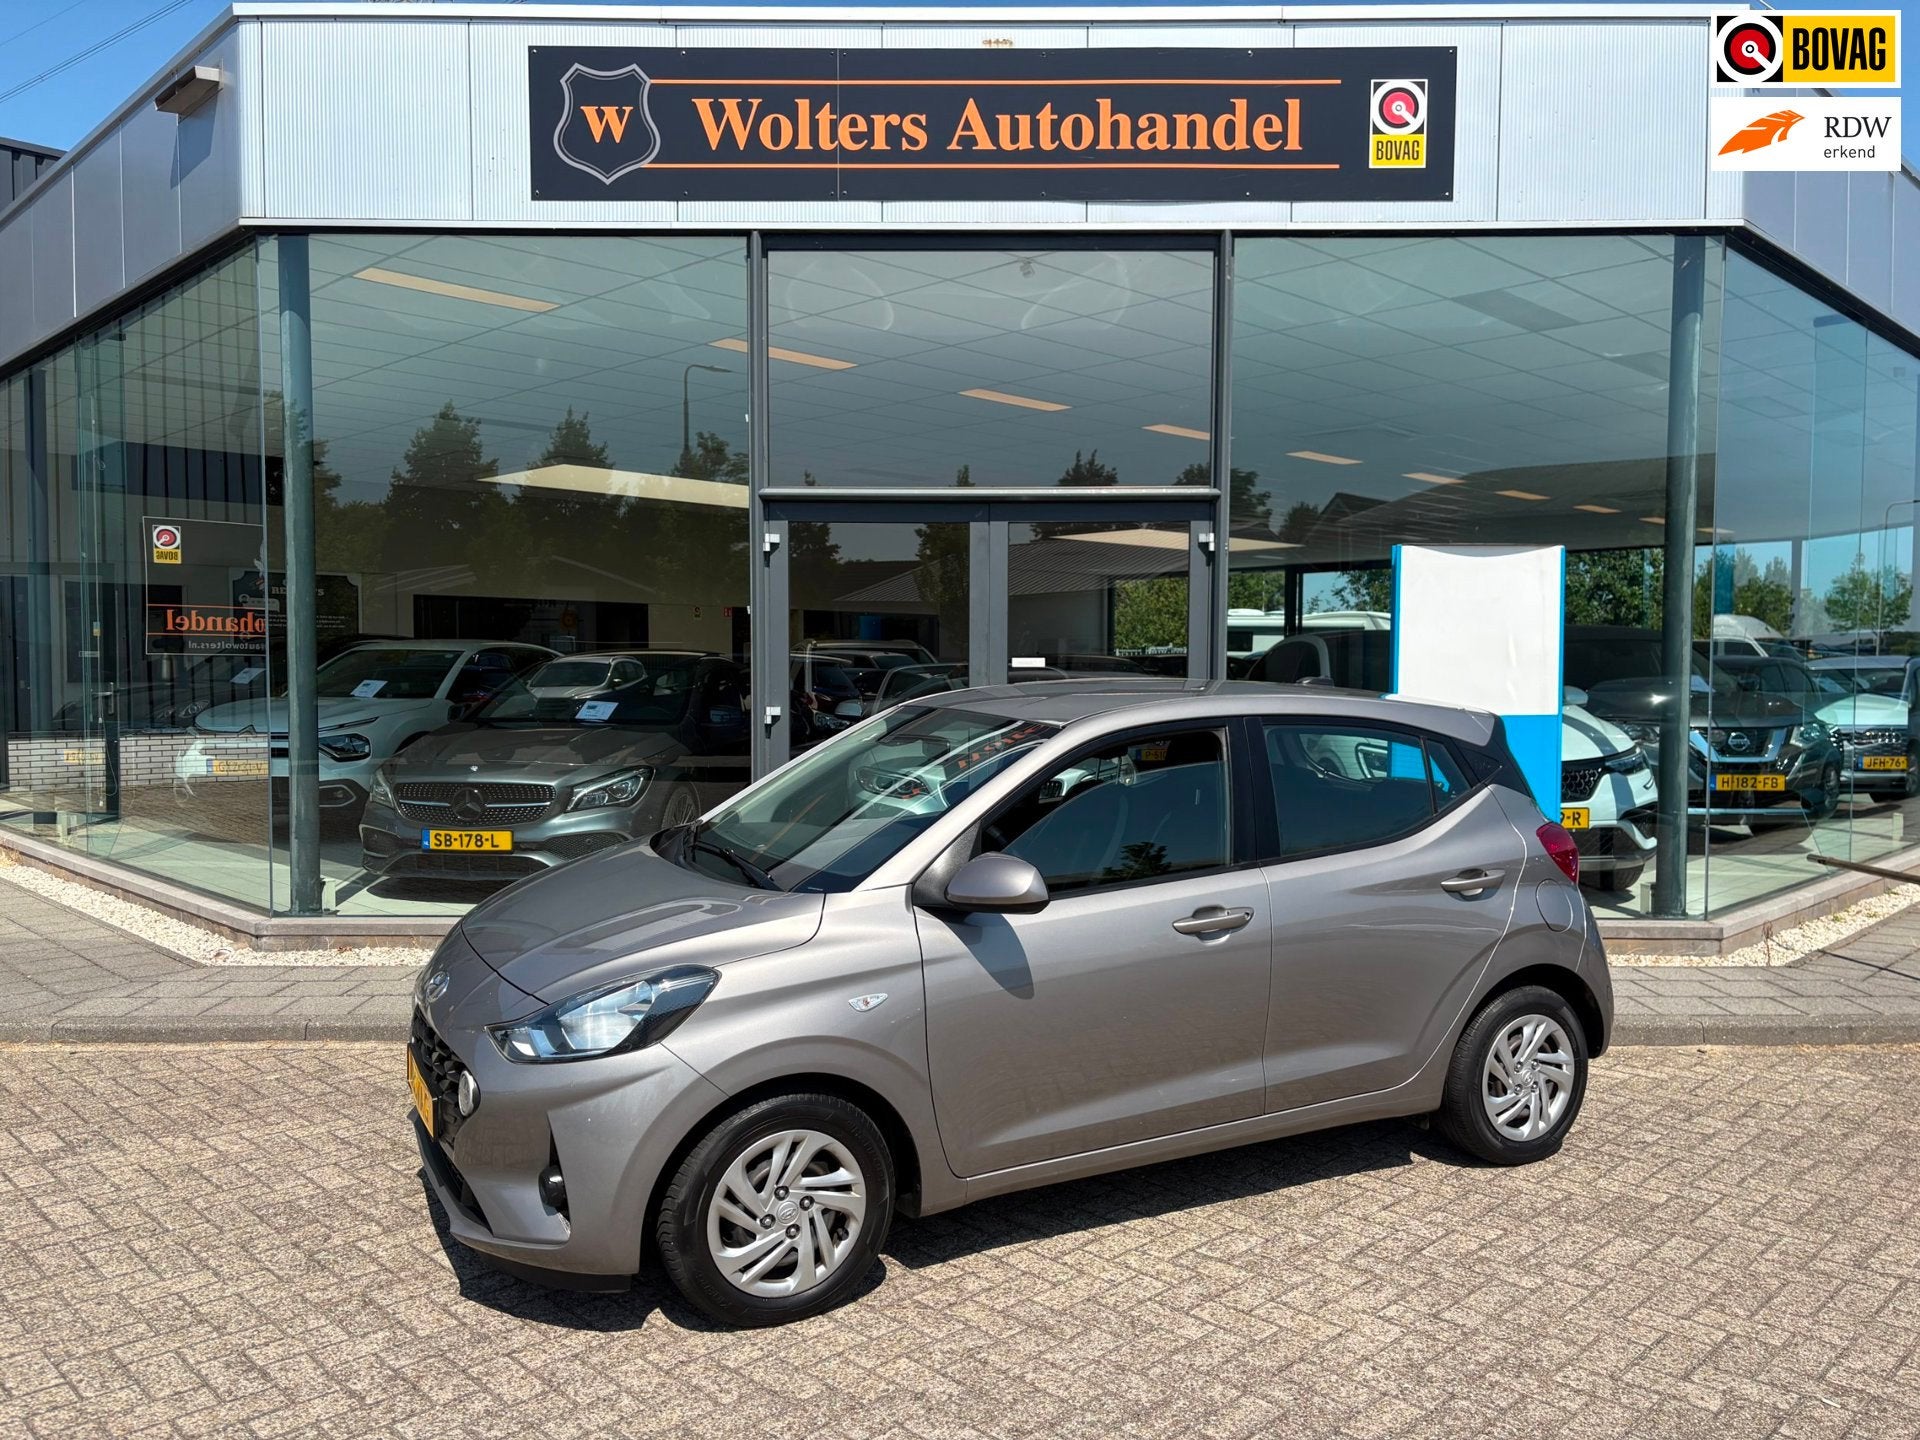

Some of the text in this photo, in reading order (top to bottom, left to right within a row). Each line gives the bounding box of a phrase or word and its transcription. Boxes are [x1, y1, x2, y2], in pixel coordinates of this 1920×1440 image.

[581, 106, 633, 143] W
[693, 98, 1303, 152] Wolters Autohandel
[1376, 139, 1420, 161] BOVAG
[1721, 776, 1778, 789] H-182-FB
[434, 832, 500, 849] SB-178-L
